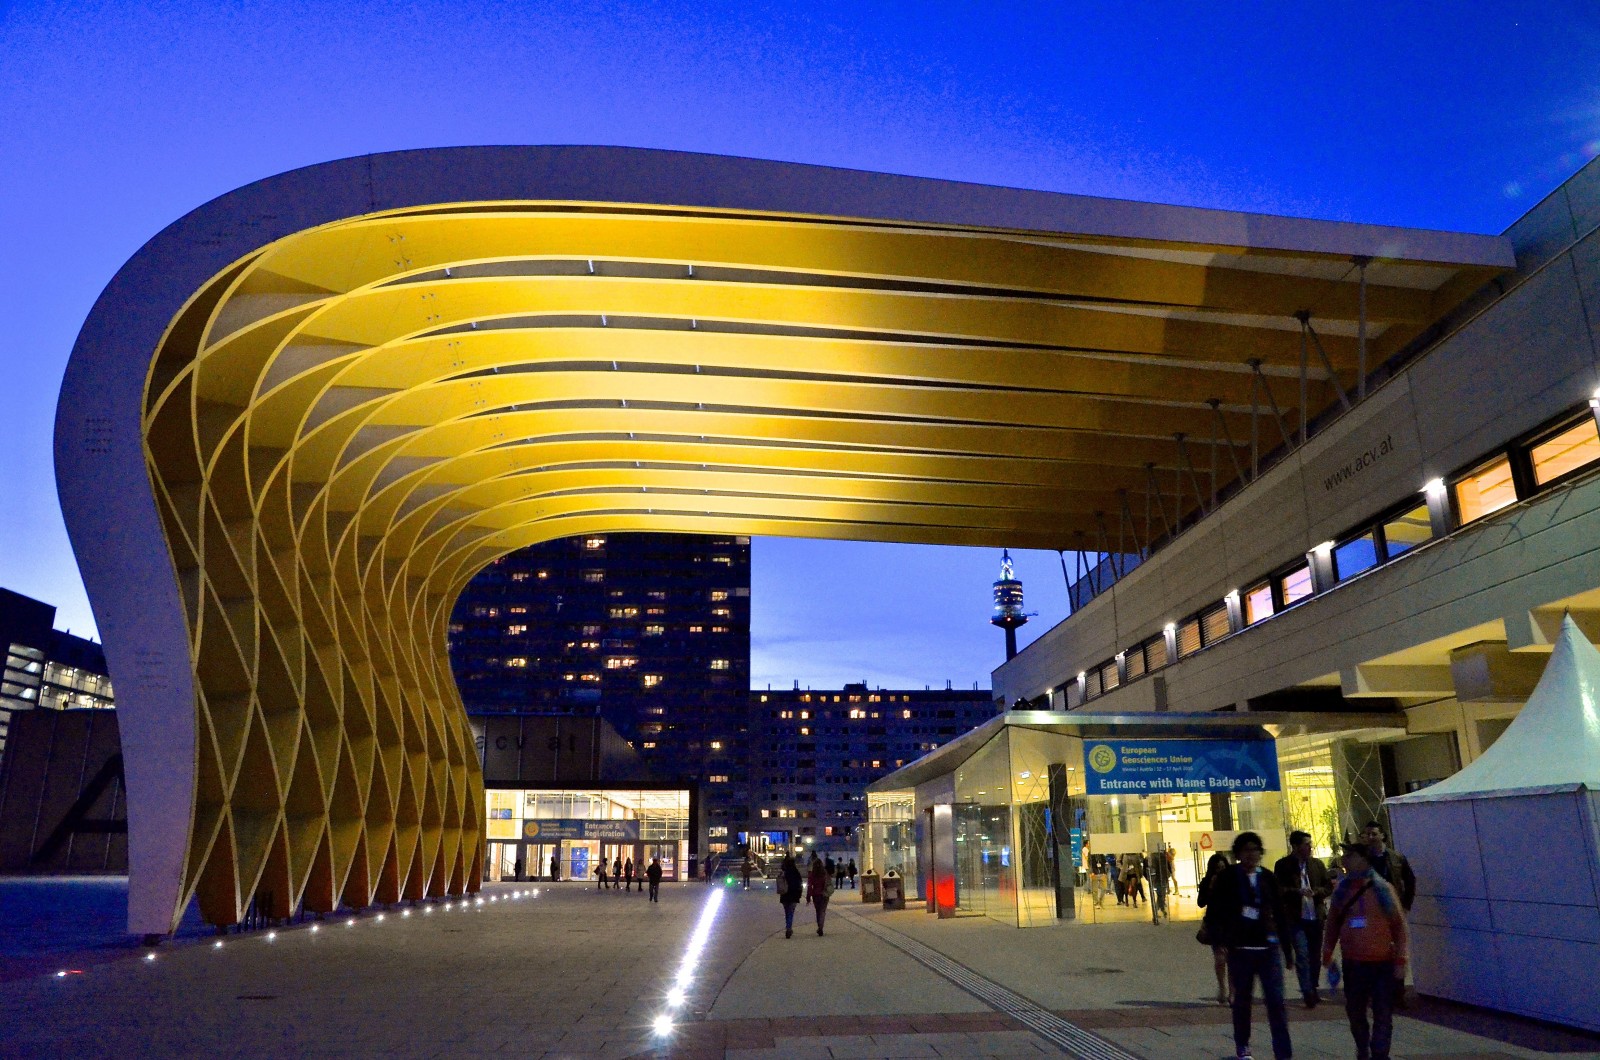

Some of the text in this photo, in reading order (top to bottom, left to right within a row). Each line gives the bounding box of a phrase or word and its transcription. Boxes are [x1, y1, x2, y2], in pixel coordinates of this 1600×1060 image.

[1323, 434, 1395, 492] www.acv.at
[1121, 746, 1157, 755] European
[1122, 755, 1193, 764] Geosciences Union
[1100, 776, 1267, 789] Entrance with Name Badge only
[585, 830, 625, 838] Registration
